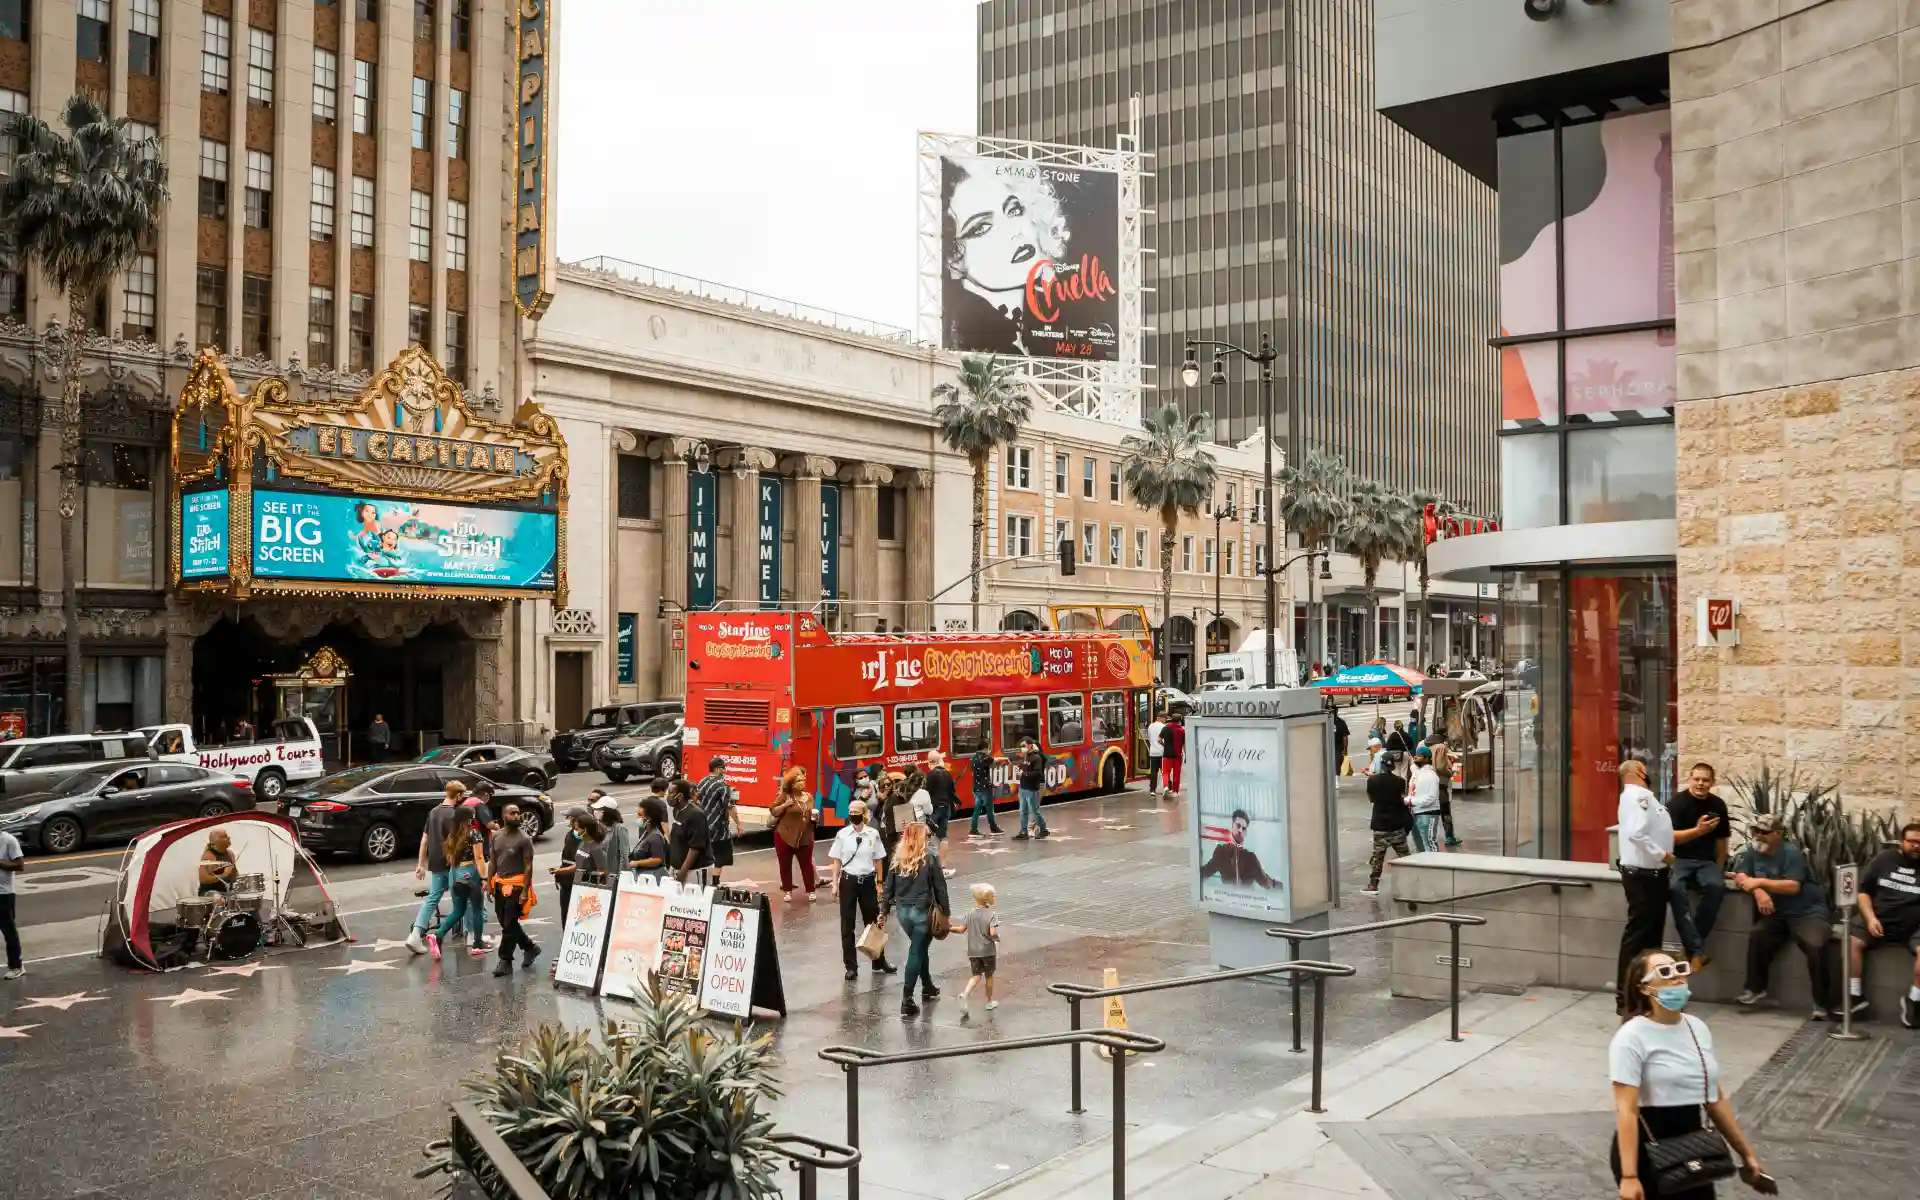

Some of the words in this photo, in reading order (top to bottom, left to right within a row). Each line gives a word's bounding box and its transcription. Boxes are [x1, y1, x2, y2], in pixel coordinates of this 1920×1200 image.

[1041, 170, 1081, 183] STONE
[1025, 253, 1116, 323] Cruella
[1030, 330, 1065, 339] THEATERS
[1055, 341, 1077, 357] MAY
[1080, 344, 1093, 356] 28
[1572, 380, 1669, 401] SEPHORA
[318, 426, 359, 457] EL
[367, 432, 515, 473] CAPITAN
[262, 501, 288, 514] SEE
[292, 503, 303, 515] IT
[260, 515, 322, 546] BIG
[692, 486, 707, 589] JIMMY
[821, 502, 831, 574] LIVE
[760, 485, 773, 600] KIMMEL
[258, 545, 325, 564] SCREEN
[1049, 647, 1063, 660] Hop
[1063, 646, 1073, 659] On
[1050, 662, 1063, 675] Hop
[199, 748, 272, 771] Hollywood
[276, 745, 316, 761] Tours
[1204, 737, 1234, 767] Only
[1238, 748, 1266, 761] one
[685, 919, 707, 935] OPEN
[720, 929, 746, 942] CABO
[569, 931, 596, 949] NOW
[719, 938, 745, 950] WABO
[565, 949, 594, 969] OPEN
[714, 952, 747, 973] NOW
[710, 974, 745, 995] OPEN
[722, 1000, 741, 1012] LEVEL
